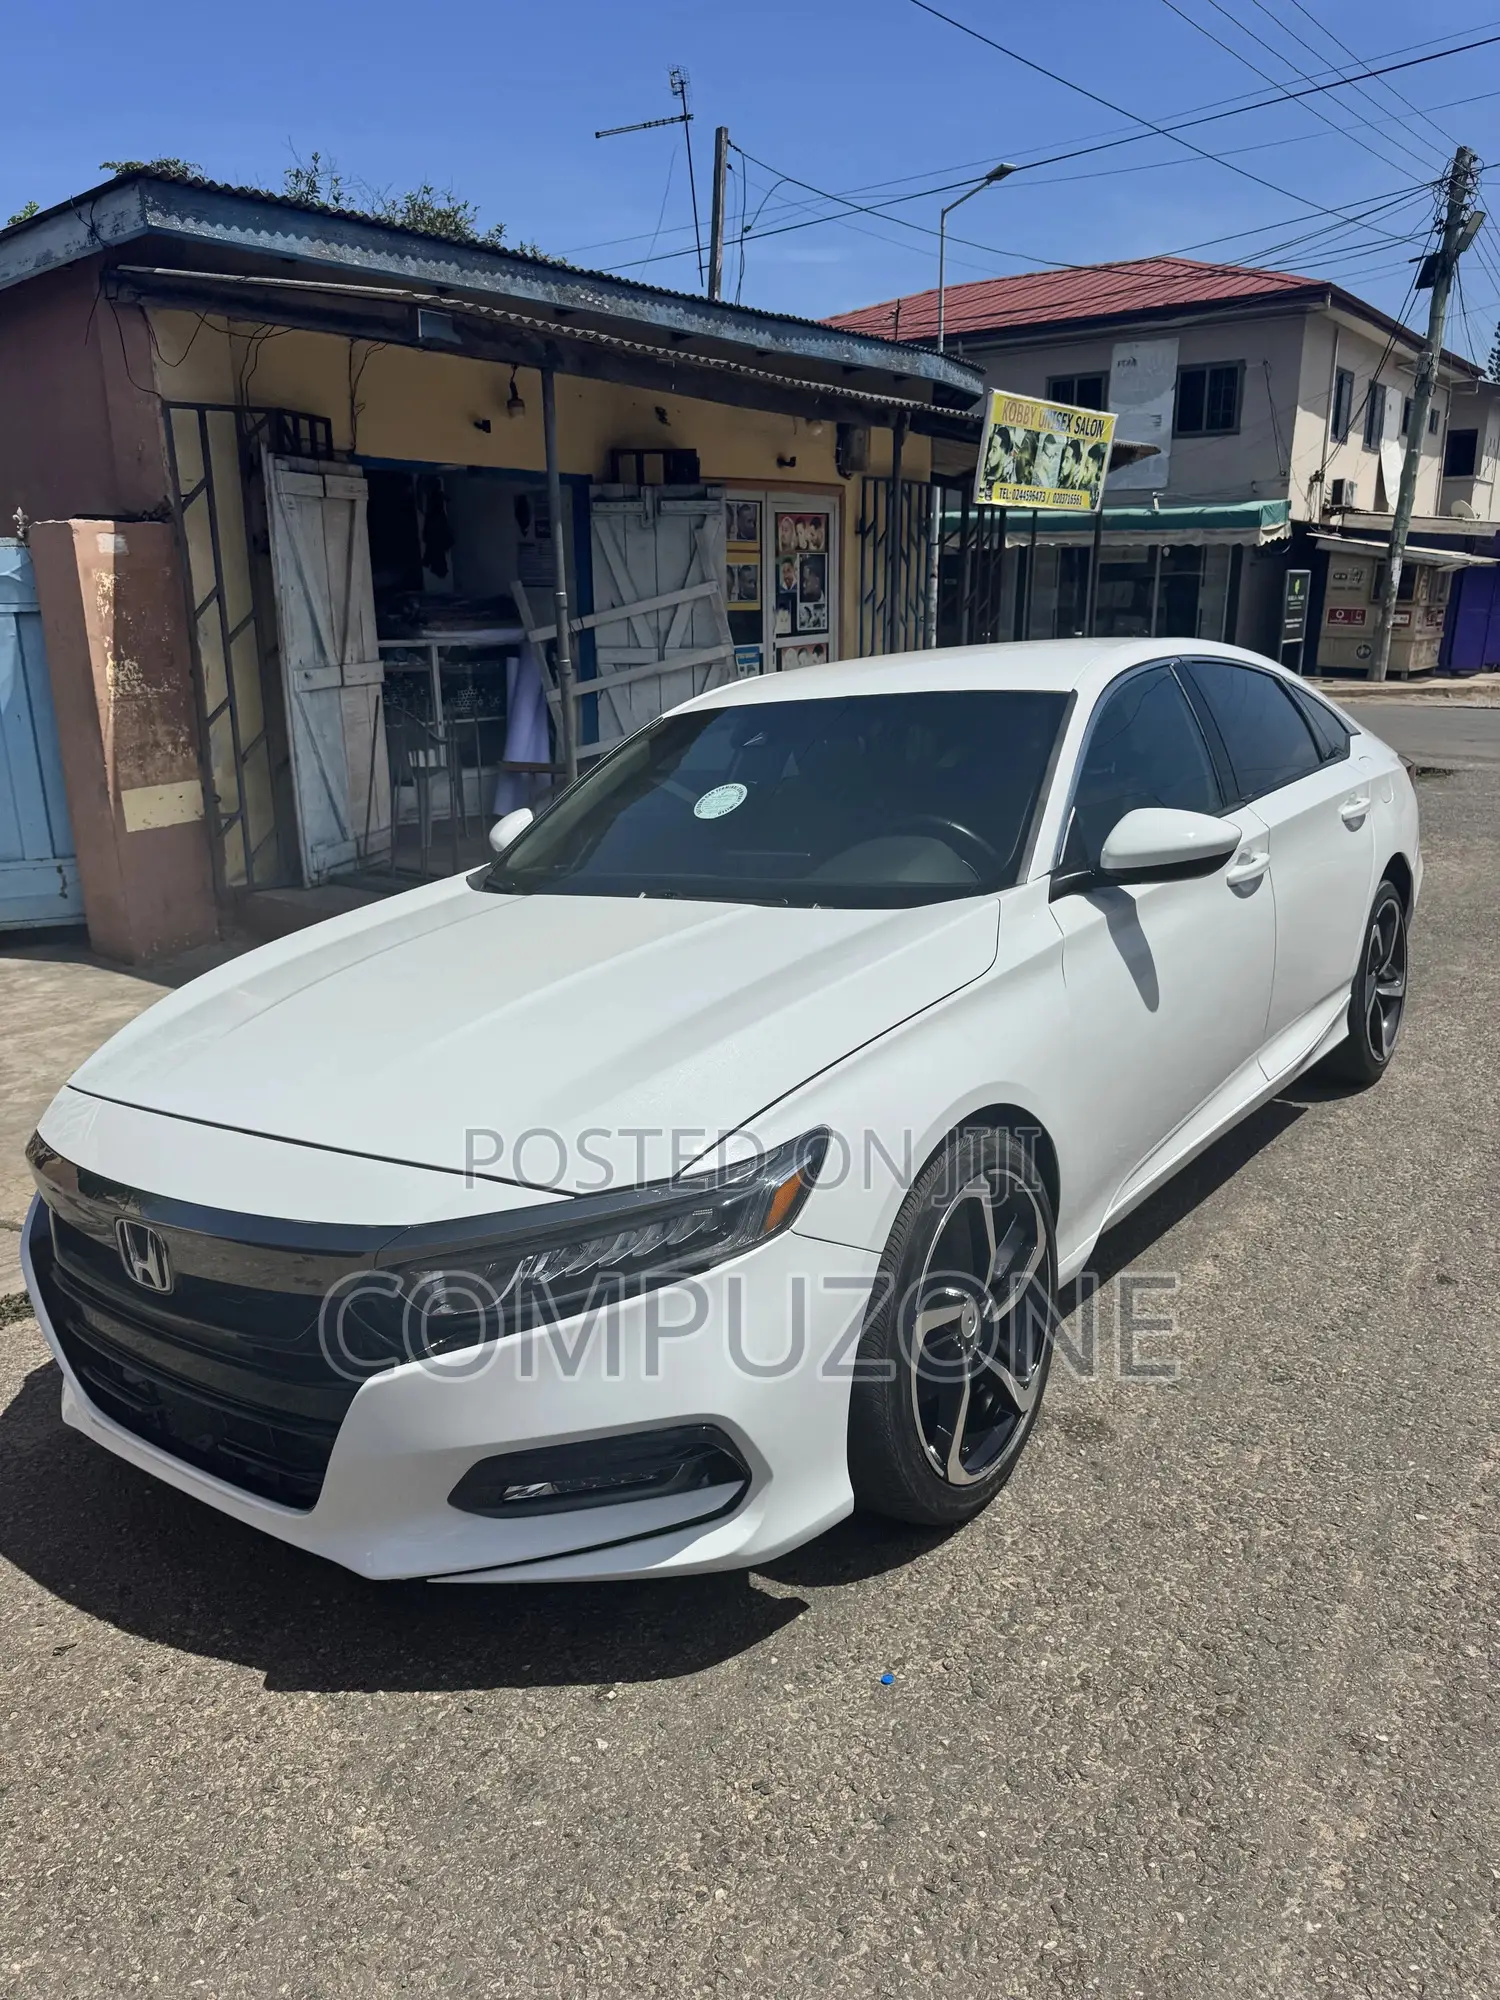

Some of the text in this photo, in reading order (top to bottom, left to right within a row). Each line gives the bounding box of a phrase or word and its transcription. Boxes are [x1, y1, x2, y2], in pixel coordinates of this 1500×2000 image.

[1002, 401, 1105, 438] KOBBY UNISEX SALON
[1000, 488, 1011, 500] TEL:
